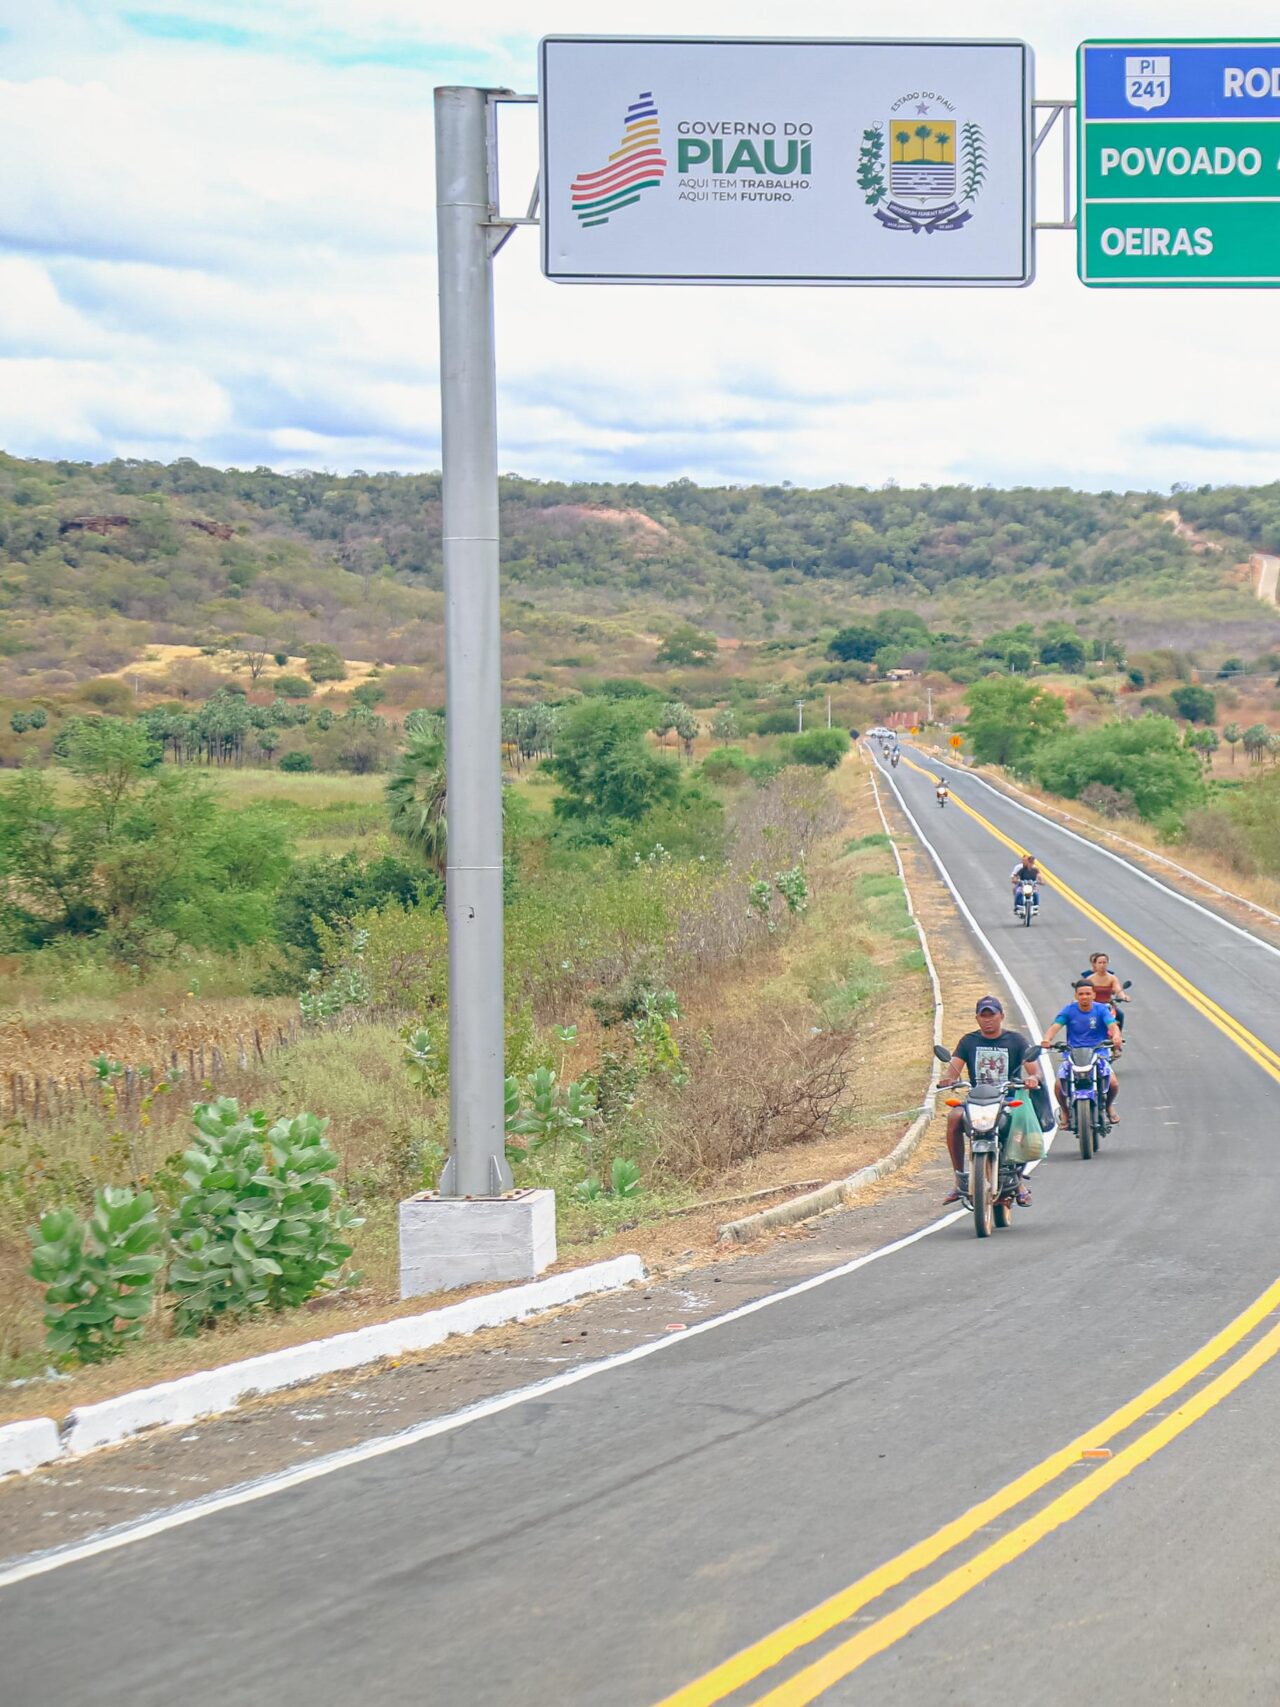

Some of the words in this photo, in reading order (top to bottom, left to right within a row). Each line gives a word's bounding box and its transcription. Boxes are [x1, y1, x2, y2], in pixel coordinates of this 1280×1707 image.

[1140, 59, 1156, 75] PI
[1131, 80, 1166, 99] 241
[890, 91, 920, 112] ESTADO
[921, 91, 935, 99] DO
[677, 121, 777, 136] GOVERNO
[784, 122, 813, 136] DO
[677, 138, 812, 175] PIAUÍ
[1100, 147, 1262, 176] POVOADO
[679, 179, 709, 189] AQUI
[712, 179, 737, 188] TEM
[740, 179, 812, 189] TRABALHO.
[679, 192, 709, 202] AQUI
[712, 192, 737, 201] TEM
[740, 192, 794, 202] FUTURO.
[1101, 228, 1214, 256] OEIRAS
